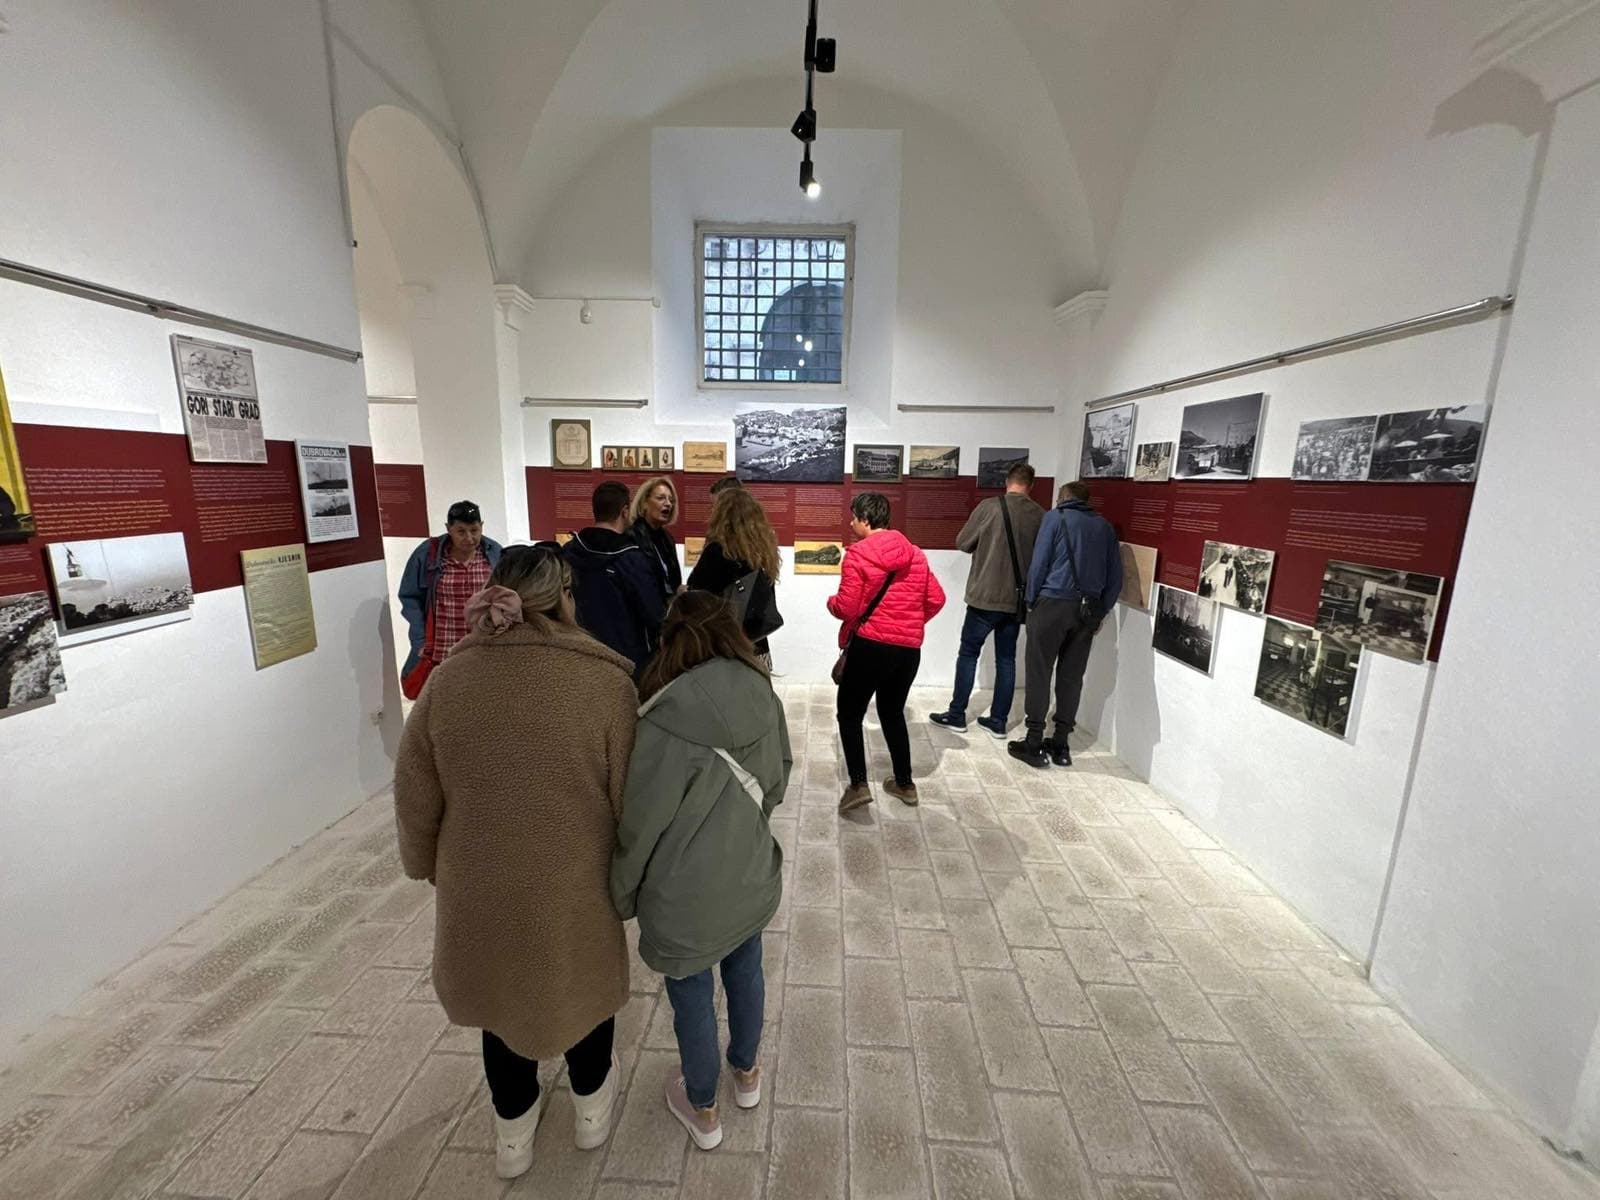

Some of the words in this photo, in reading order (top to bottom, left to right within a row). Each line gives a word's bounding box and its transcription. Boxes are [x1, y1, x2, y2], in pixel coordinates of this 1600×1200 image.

[187, 396, 209, 415] GORI
[213, 399, 235, 418] STARI
[239, 402, 260, 419] GRAD
